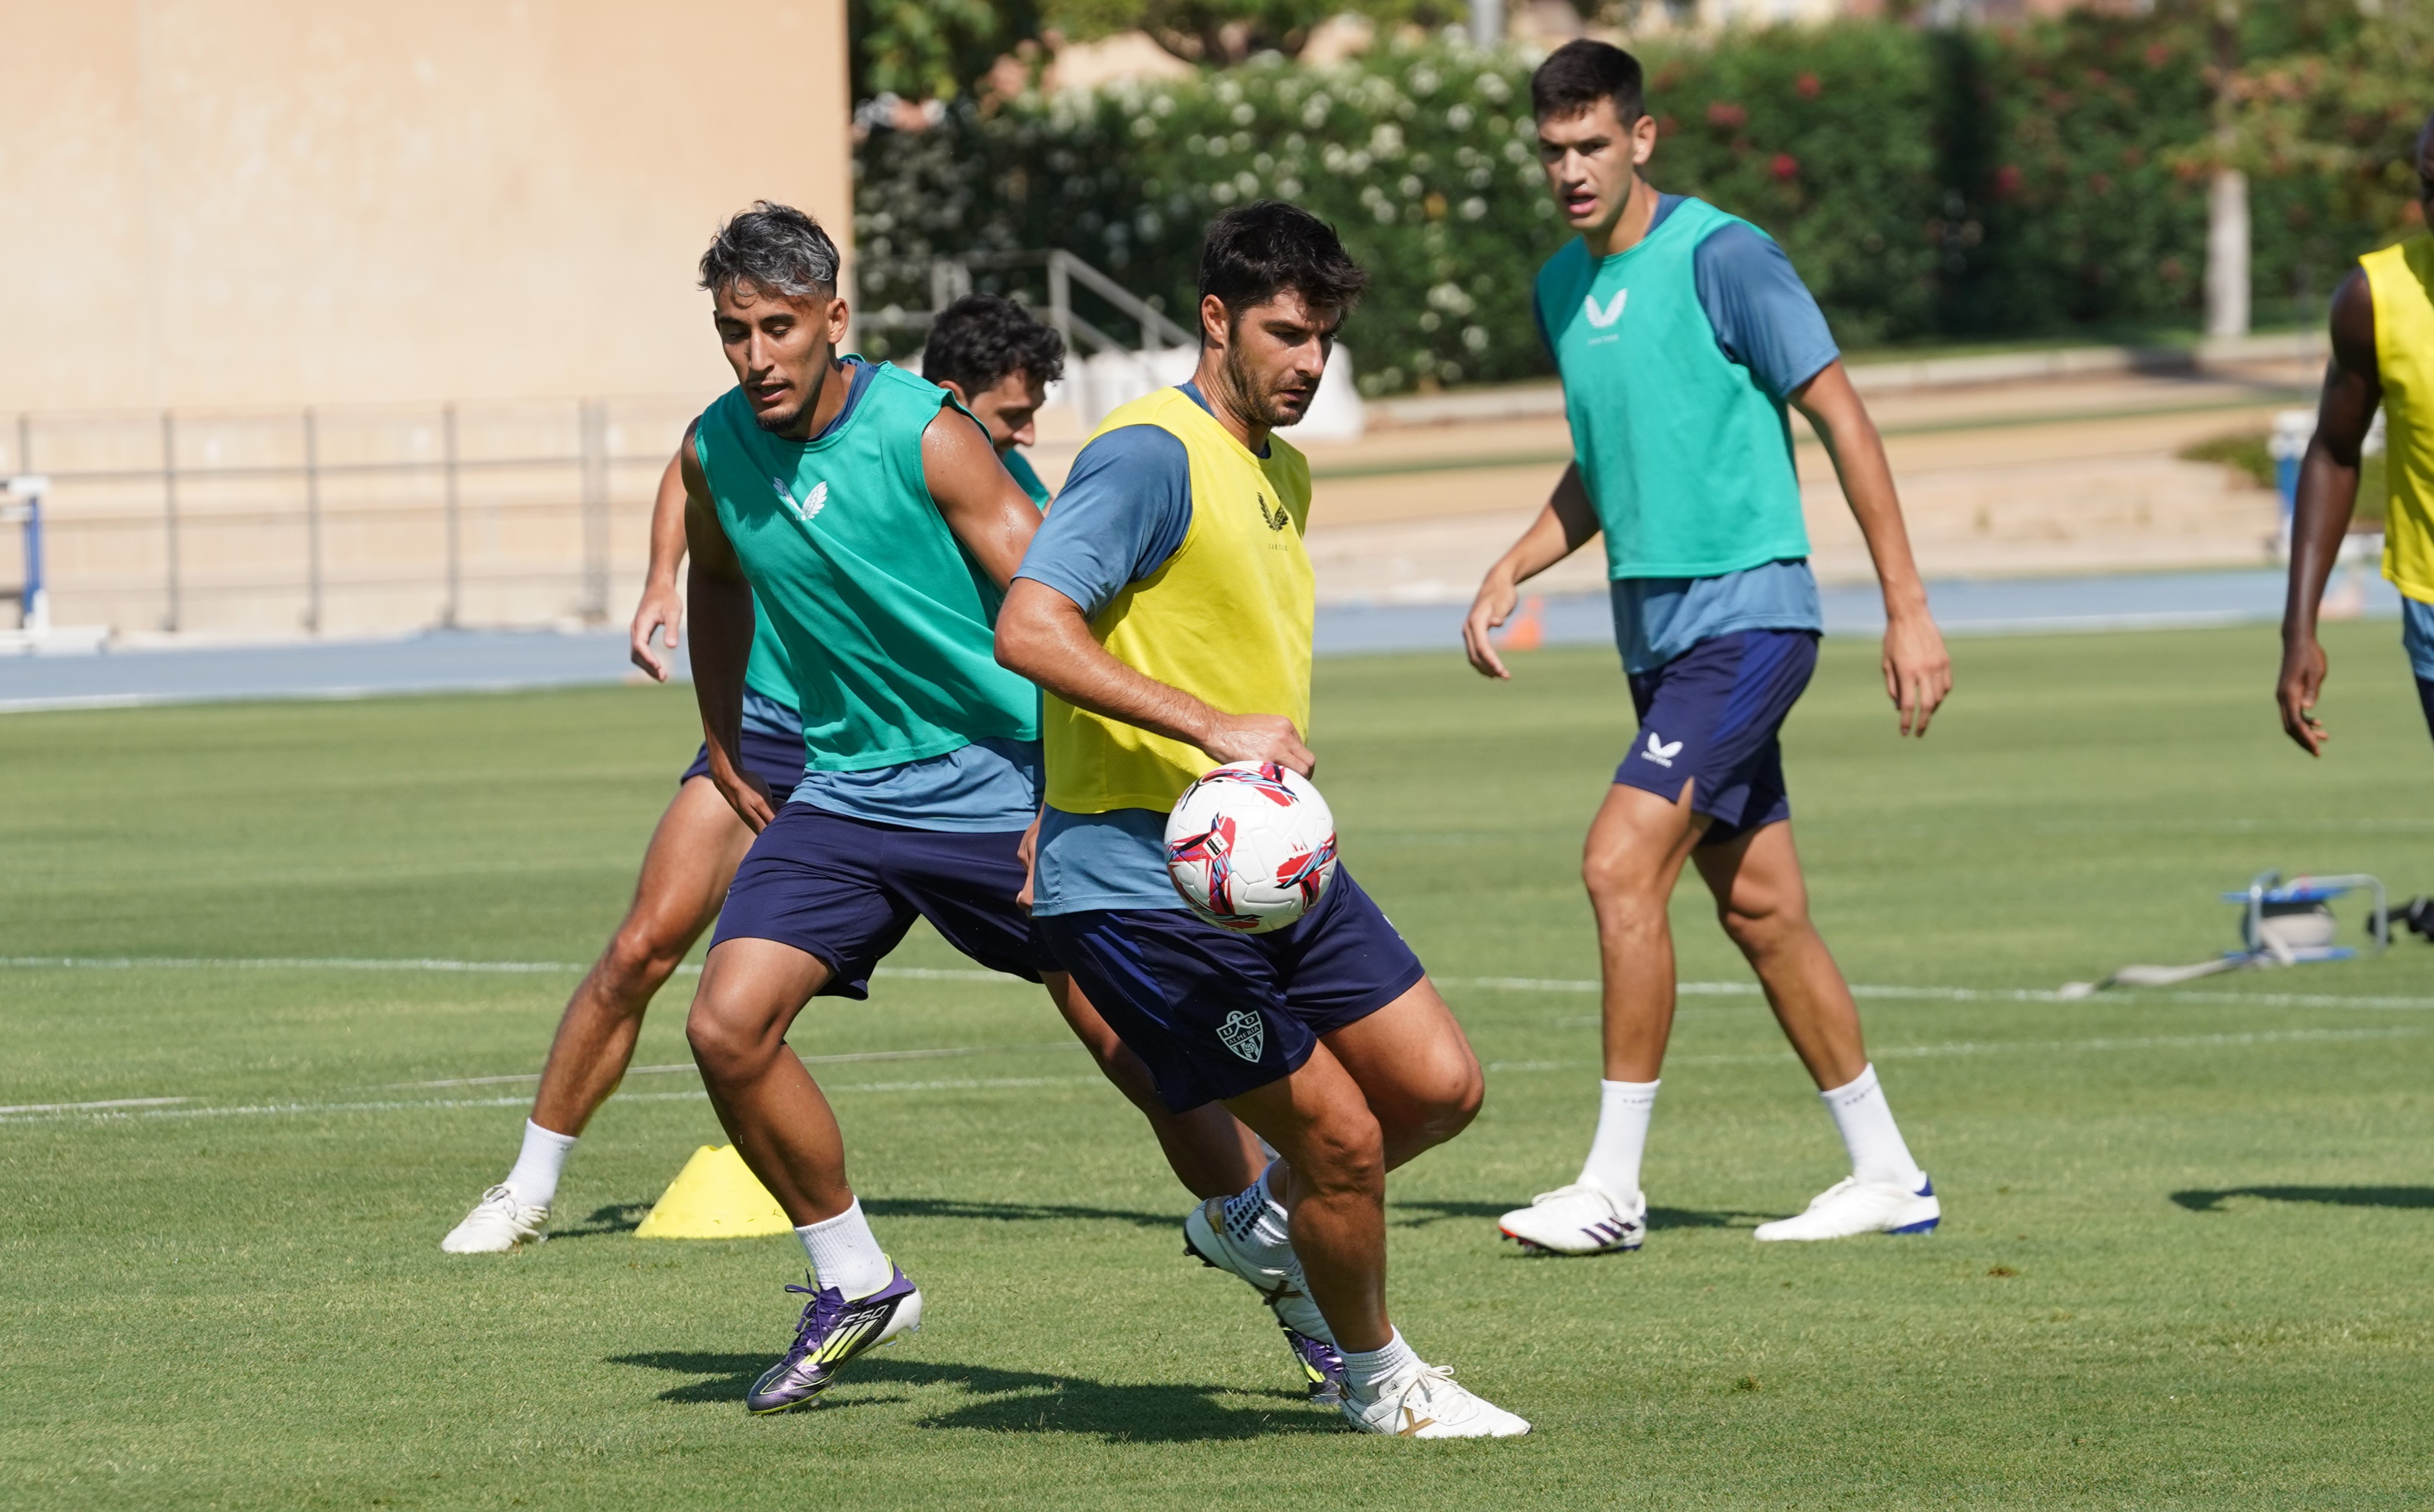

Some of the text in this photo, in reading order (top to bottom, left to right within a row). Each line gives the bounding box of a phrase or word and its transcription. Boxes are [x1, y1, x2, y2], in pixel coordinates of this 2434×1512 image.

[1223, 1016, 1254, 1035] U D
[1229, 1026, 1259, 1044] ALMERIA
[837, 1304, 889, 1329] F50
